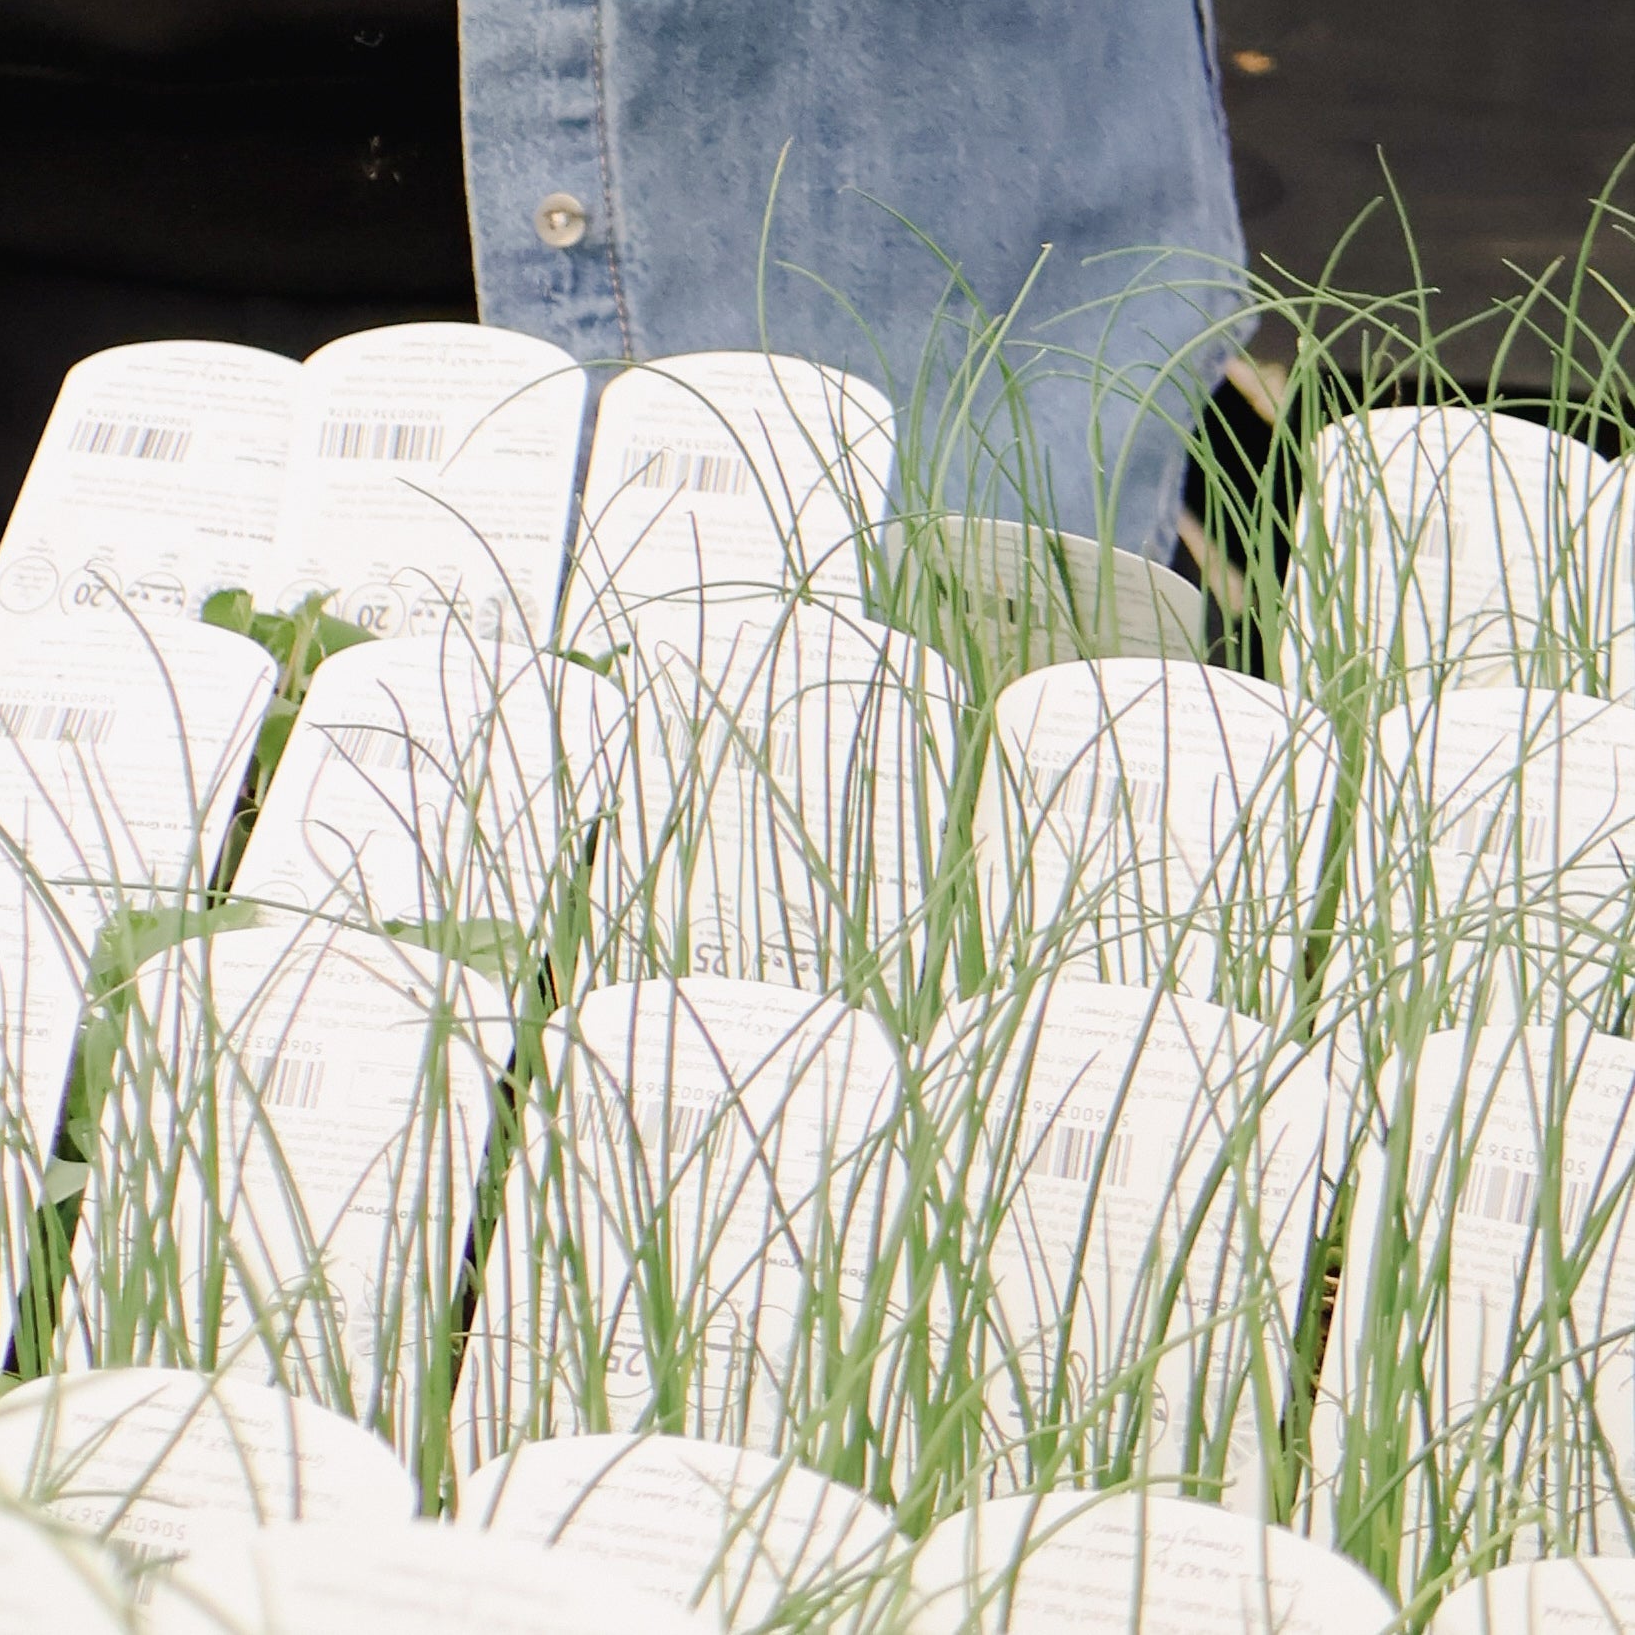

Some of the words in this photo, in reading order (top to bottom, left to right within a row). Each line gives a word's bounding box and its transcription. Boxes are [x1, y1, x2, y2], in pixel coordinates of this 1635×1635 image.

[74, 582, 106, 607] 20
[357, 605, 389, 630] 20
[694, 943, 730, 977] 25
[605, 1340, 644, 1377] 25
